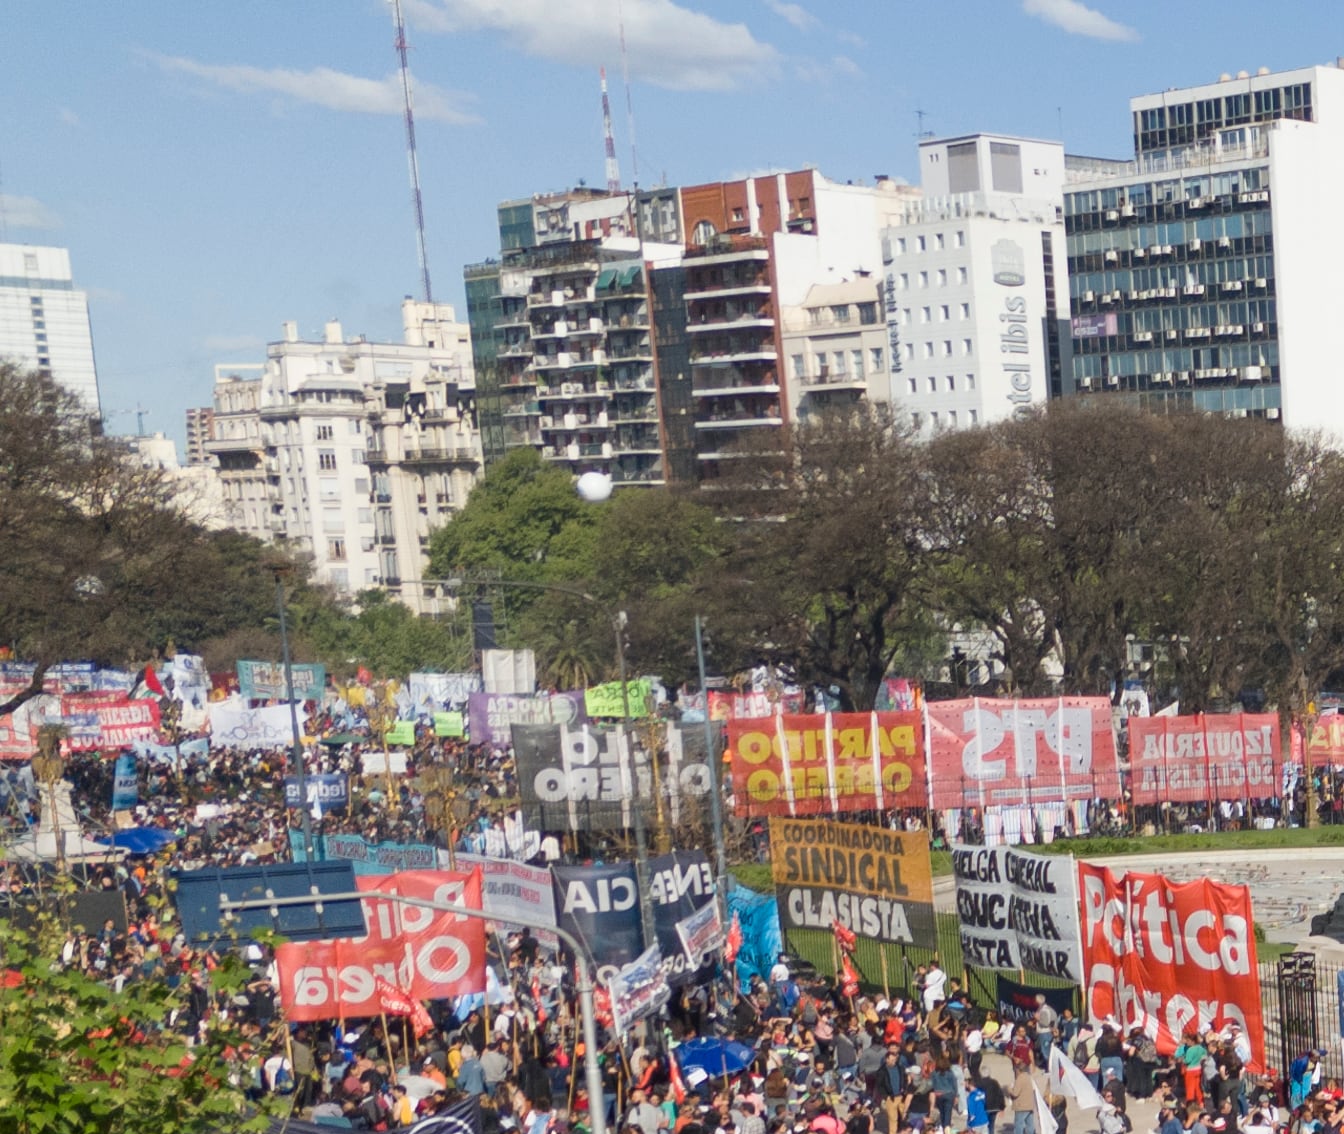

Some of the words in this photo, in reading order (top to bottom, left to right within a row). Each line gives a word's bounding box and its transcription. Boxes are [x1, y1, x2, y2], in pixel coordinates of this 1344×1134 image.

[1000, 295, 1029, 354] ibis
[1001, 363, 1033, 422] otel
[782, 822, 904, 857] COORDINADORA
[785, 845, 910, 897] SINDICAL
[787, 886, 914, 944] CLASISTA
